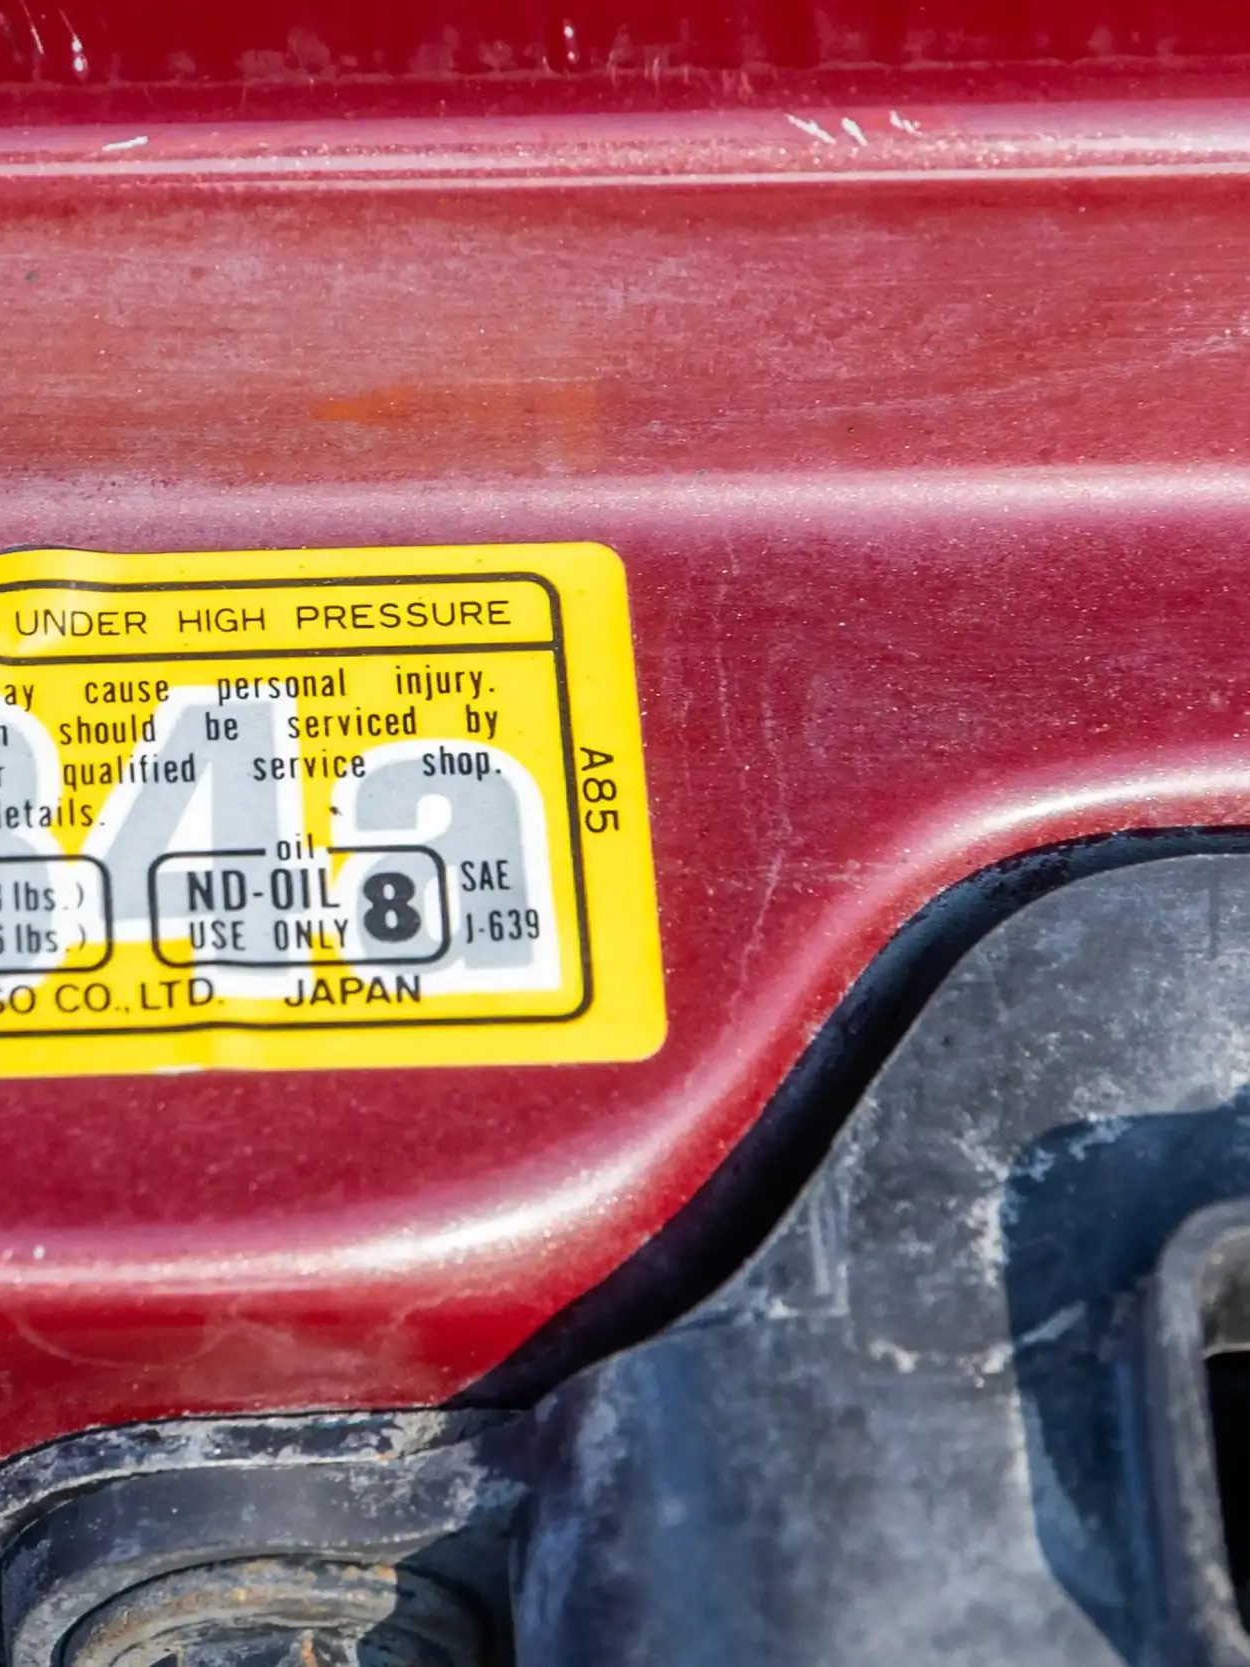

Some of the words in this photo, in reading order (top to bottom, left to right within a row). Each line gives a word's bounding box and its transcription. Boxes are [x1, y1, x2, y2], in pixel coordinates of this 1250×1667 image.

[15, 610, 148, 637] UNDER
[178, 607, 266, 633] HIGH
[296, 600, 511, 630] PRESSURE
[84, 679, 170, 704] cause
[217, 668, 346, 705] personal
[395, 664, 496, 701] injury.
[59, 714, 157, 746] should
[205, 713, 239, 742] be
[288, 707, 418, 738] serviced
[465, 708, 500, 740] by
[62, 753, 197, 788] qualified
[253, 753, 367, 782] service
[422, 749, 503, 782] shop.
[580, 746, 620, 833] A85
[276, 834, 316, 861] oil
[186, 866, 341, 912] ND-OIL
[461, 859, 510, 892] SAE
[363, 871, 421, 942] 8
[189, 919, 246, 952] USE
[273, 917, 350, 951] ONLY
[465, 909, 540, 944] J-639
[285, 975, 422, 1008] JAPAN
